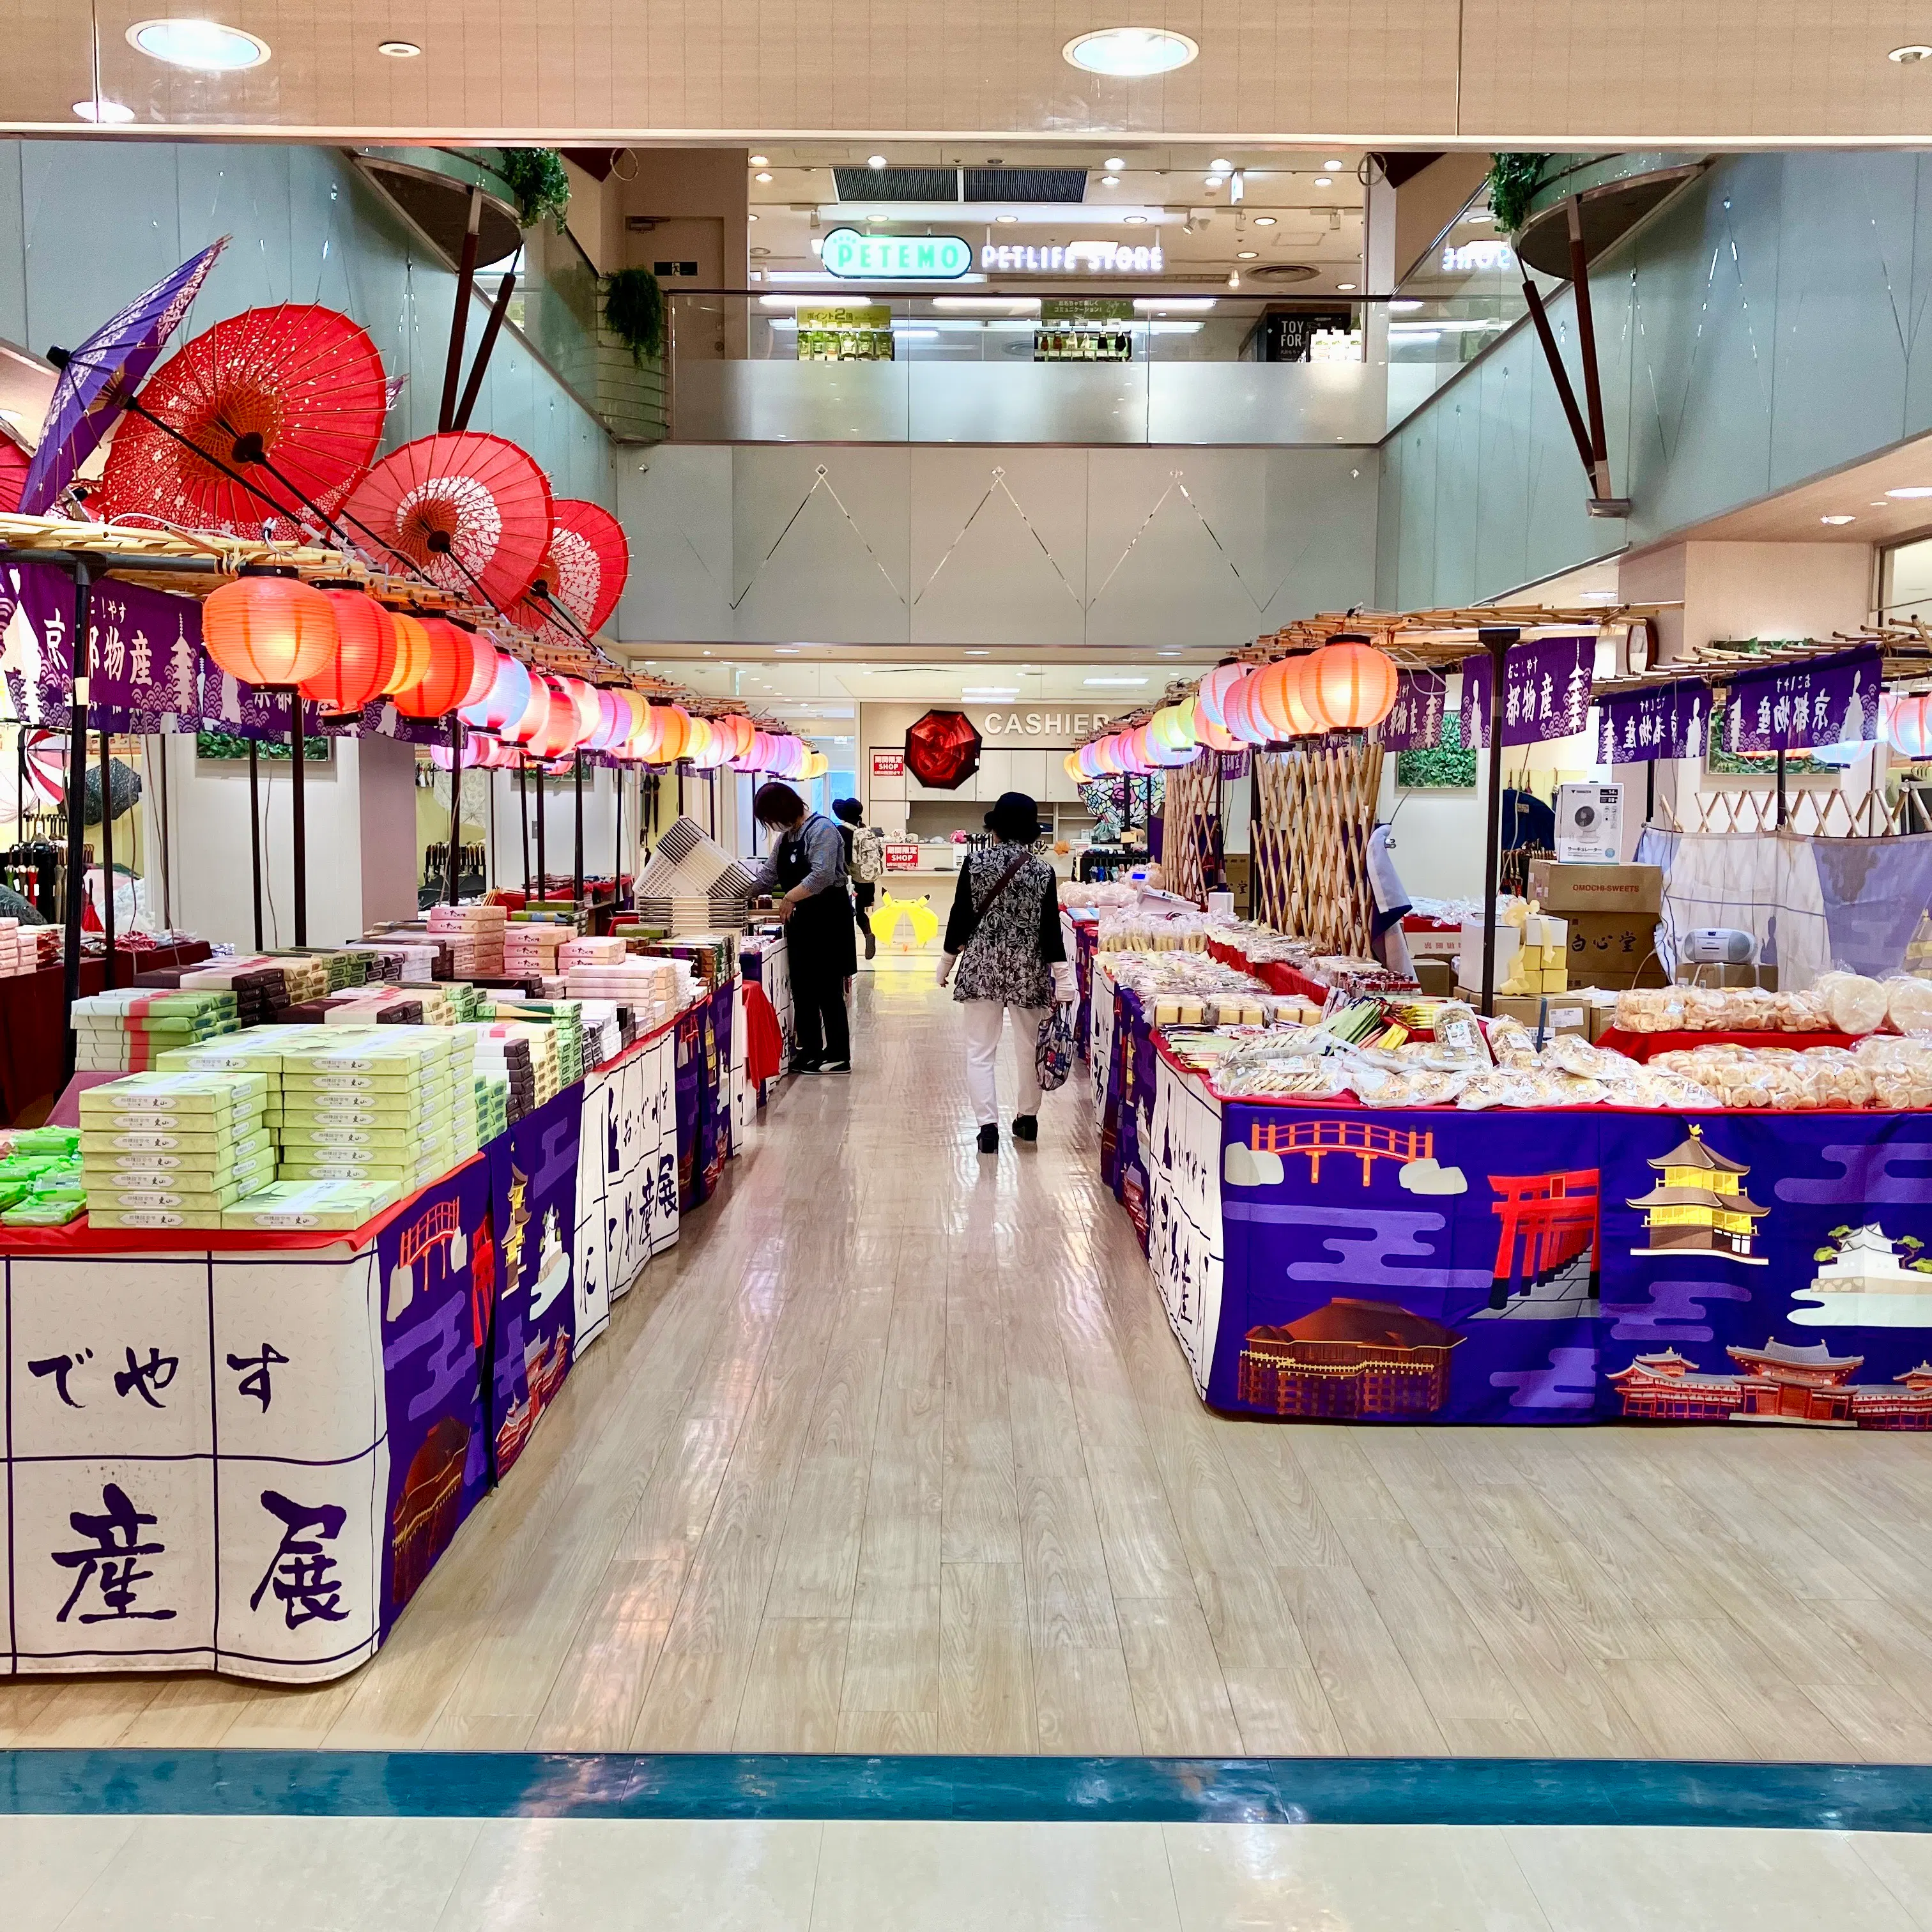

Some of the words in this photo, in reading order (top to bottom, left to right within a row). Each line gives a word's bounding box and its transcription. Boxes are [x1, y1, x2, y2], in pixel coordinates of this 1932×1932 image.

[838, 244, 959, 269] PETEMO
[981, 245, 1076, 269] PETLIFE
[1281, 321, 1304, 334] TOY
[1280, 334, 1302, 347] FOR
[1572, 884, 1639, 893] OMOCHI-SWEETS
[51, 1483, 352, 1630] 産展
